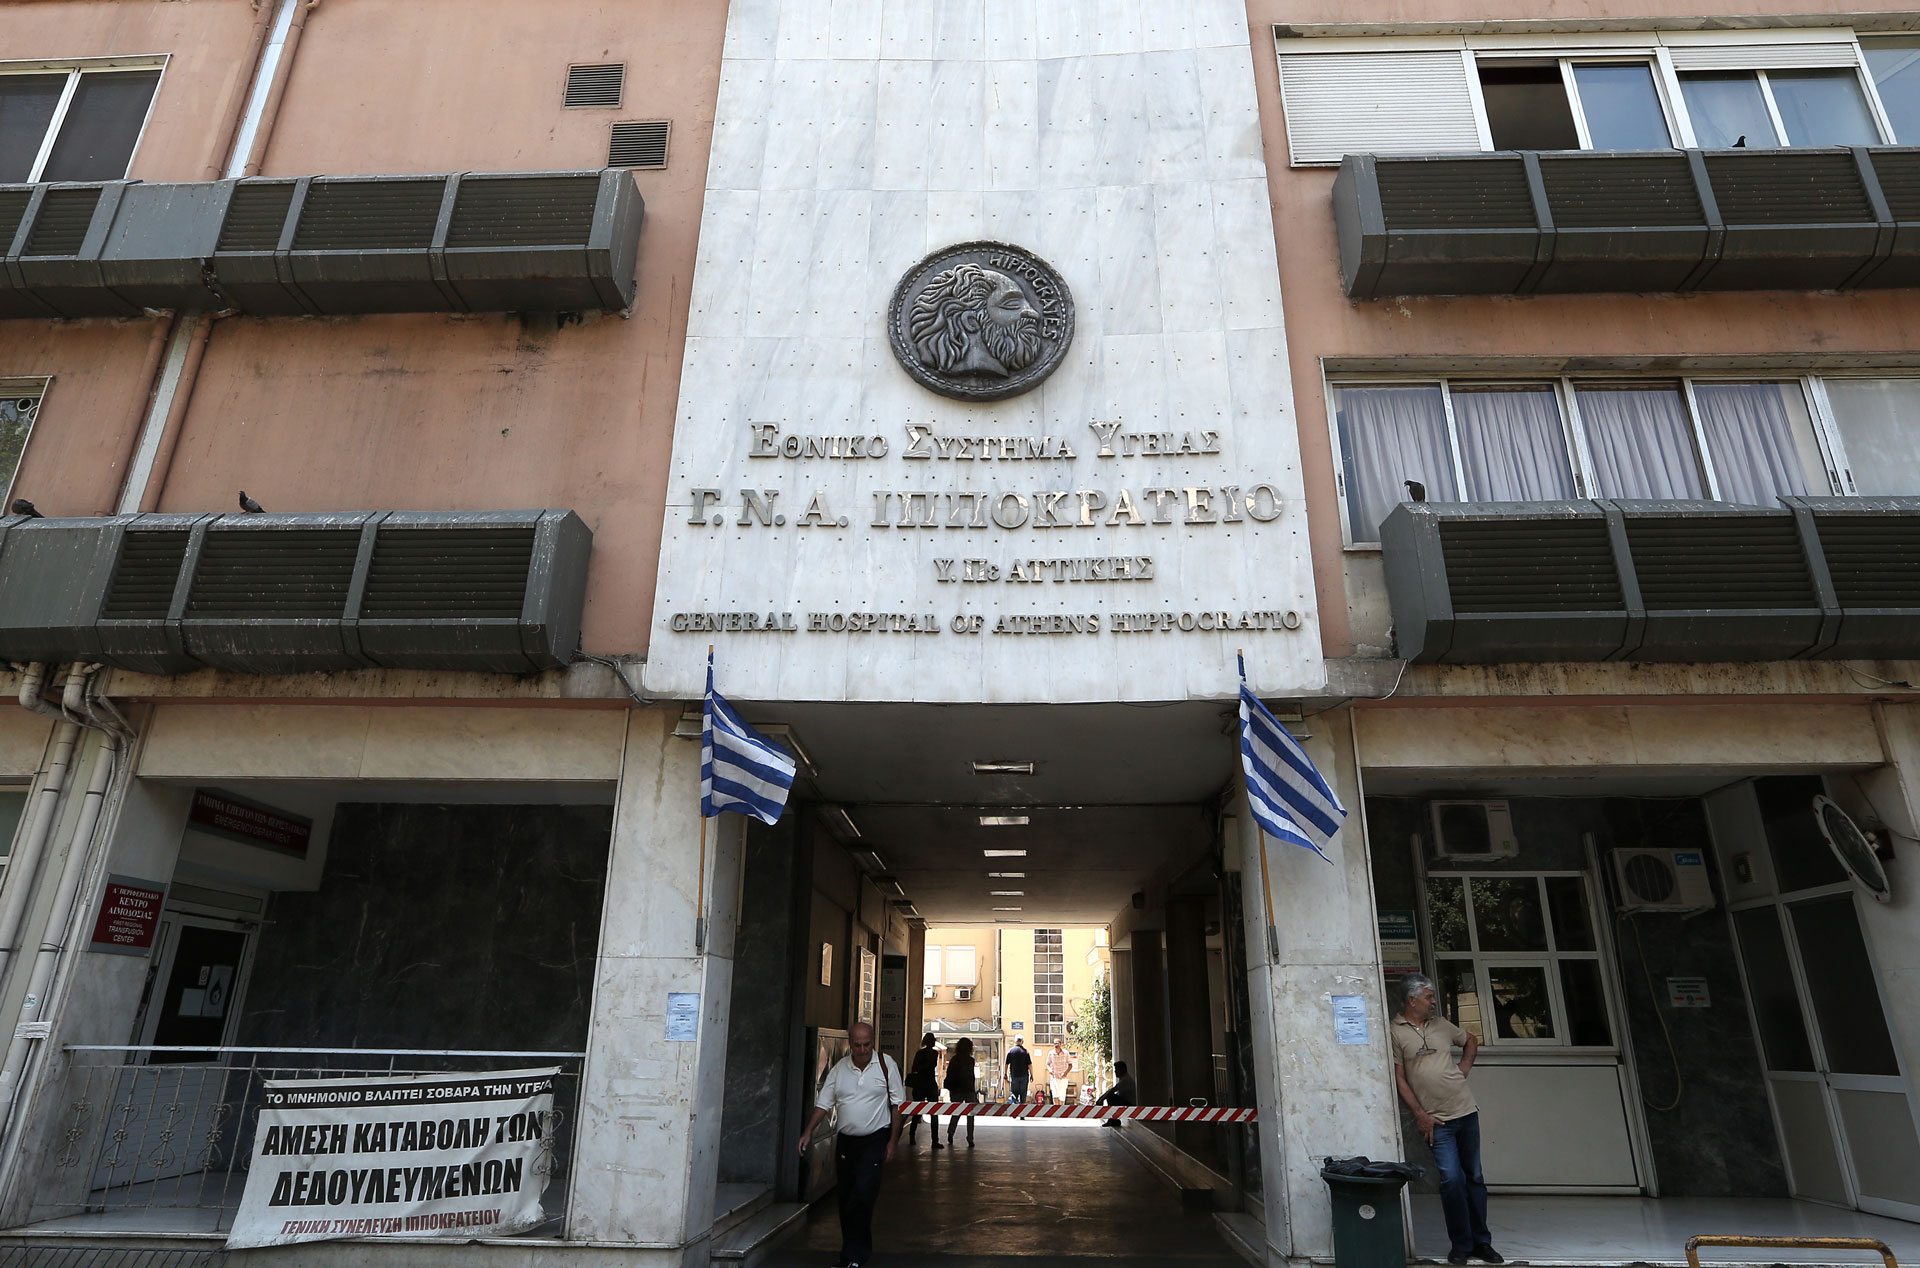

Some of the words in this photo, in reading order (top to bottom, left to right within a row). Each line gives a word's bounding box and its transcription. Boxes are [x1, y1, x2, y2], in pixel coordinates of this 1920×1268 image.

[989, 254, 1061, 341] HIPPOCRATES
[749, 421, 889, 459] ΕΘΝΙΚΟ
[902, 422, 1077, 460] ΣΥΣΤΗΜΑ
[1089, 421, 1221, 458] ΥΓΕΙΑΣ
[870, 483, 1285, 530] ΙΠΠΟΚΡΑΤΕΙΟ
[1005, 555, 1154, 583] ΑΤΤΙΚΗΣ
[670, 611, 798, 634] GENERAL
[807, 611, 941, 634] HOSPITAL
[951, 613, 986, 635] OF
[992, 612, 1101, 635] ATHENS
[1110, 610, 1301, 633] HIPPOCRATIO
[214, 814, 253, 834] EMERGENCY
[253, 825, 291, 844] DEPARTMENT
[107, 906, 153, 920] ΑΙΜΟΔΟΣΙΑΣ
[119, 896, 148, 909] ΚΕΝΤΡΟ
[108, 925, 144, 936] TRANSFUSION
[113, 934, 135, 944] CENTER
[266, 1092, 284, 1104] ΤΟ
[287, 1090, 362, 1104] ΜΝΗΜΟΝΙΟ
[364, 1088, 423, 1102] ΒΛΑΠΤΕΙ
[425, 1086, 480, 1100] ΣΟΒΑΡΑ
[483, 1083, 513, 1097] ΤΗΝ
[515, 1079, 553, 1094] ΥΓΕΙΑ
[261, 1123, 348, 1156] ΑΜΕΣΗ
[352, 1116, 490, 1154] ΚΑΤΑΒΟΛΗ
[495, 1110, 546, 1144] ΤΩΝ
[268, 1157, 523, 1207] ΔΕΔΟΥΛΕΥΜΕΝΩΝ
[280, 1219, 331, 1235] ΓΕΝΙΚΗ
[333, 1217, 403, 1234] ΣΥΝΕΛΕΥΣΗ
[405, 1208, 502, 1232] ΙΠΠΟΚΡΑΤΕΙΟΥ
